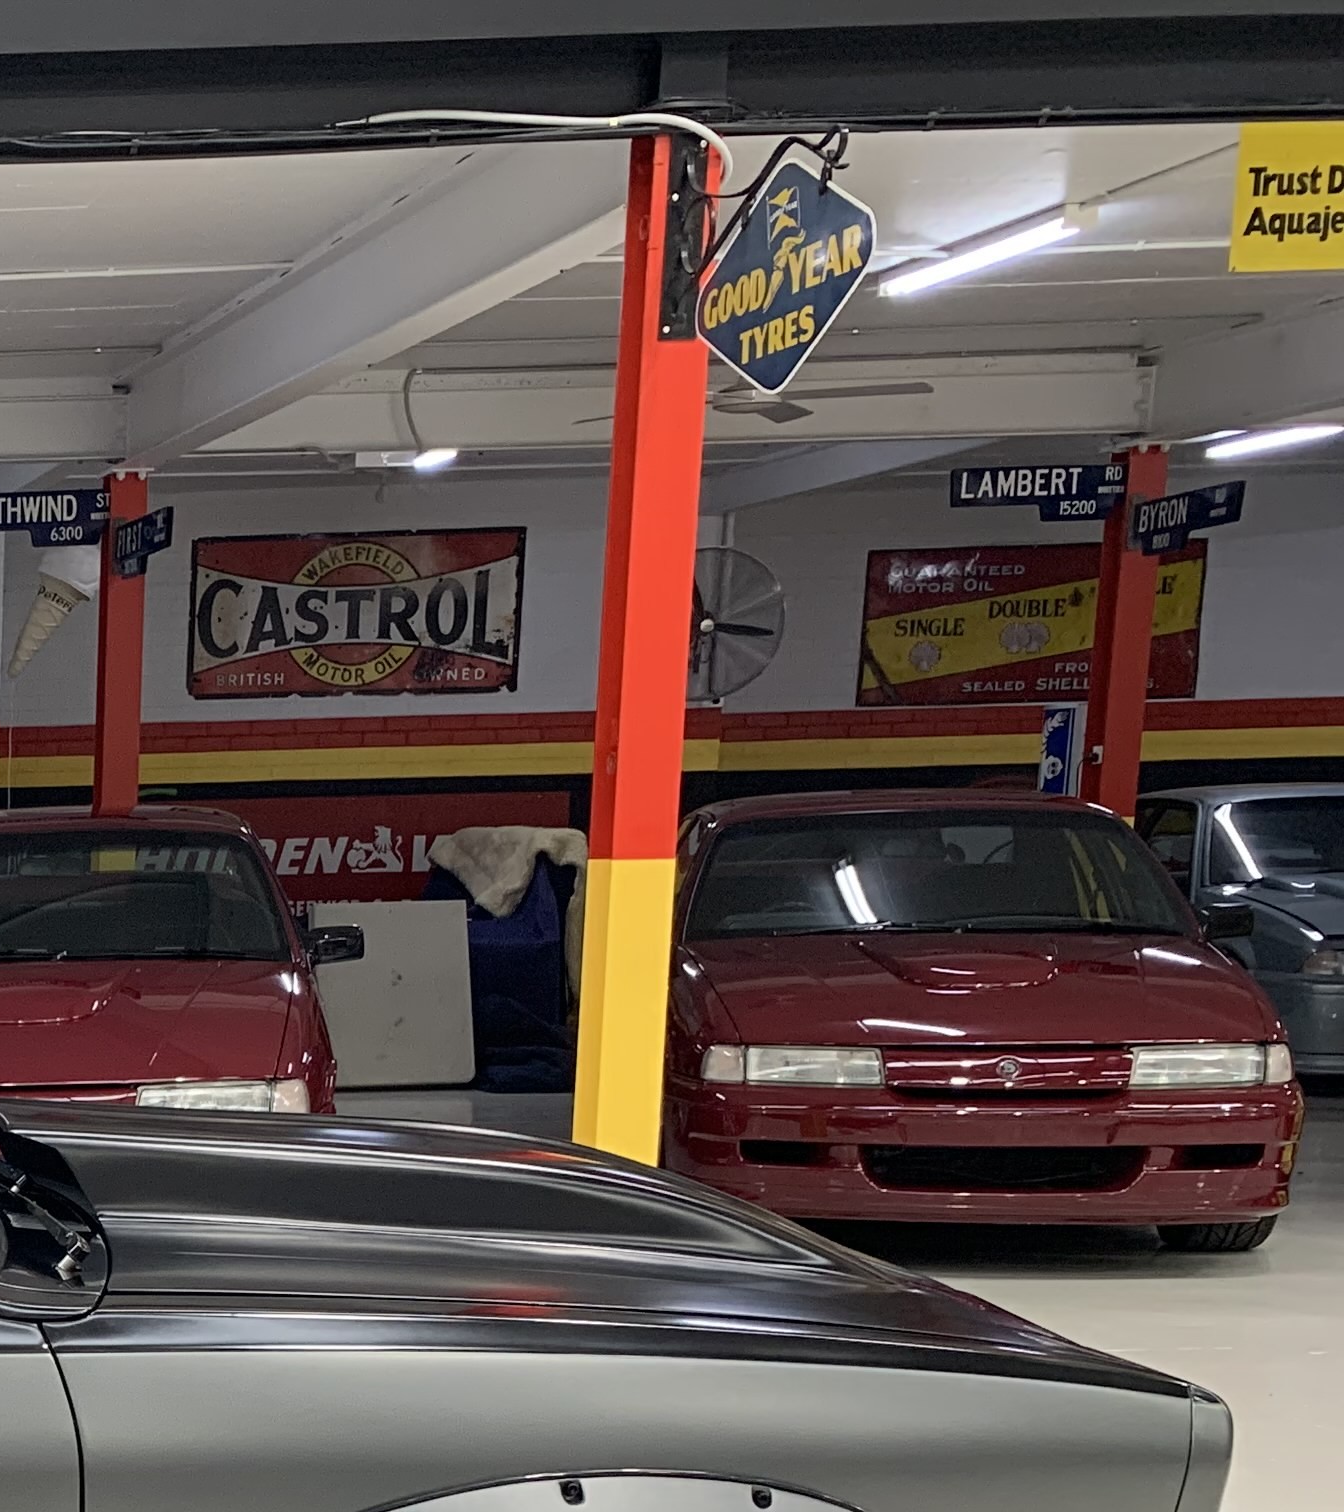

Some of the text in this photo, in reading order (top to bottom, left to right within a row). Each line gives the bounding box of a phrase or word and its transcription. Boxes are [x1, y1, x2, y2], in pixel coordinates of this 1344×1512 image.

[1249, 165, 1322, 196] Trust
[1243, 205, 1344, 242] Aquaje
[704, 224, 863, 330] GOOD YEAR
[739, 305, 815, 365] TYRES
[961, 466, 1123, 499] LAMBERT RD
[96, 492, 111, 509] ST
[1059, 500, 1096, 516] 15200
[1138, 496, 1189, 533] BYRON
[50, 526, 83, 541] 6300
[302, 547, 405, 581] WAKEFIELD
[888, 580, 954, 593] MOTOR
[197, 568, 509, 659] CASTROL
[988, 597, 1068, 619] DOUBLE
[894, 618, 965, 637] SINGLE
[374, 653, 403, 676] OIL
[1055, 662, 1090, 674] FRO
[216, 672, 285, 687] BRITISH
[962, 677, 1090, 692] SEALED SHELL
